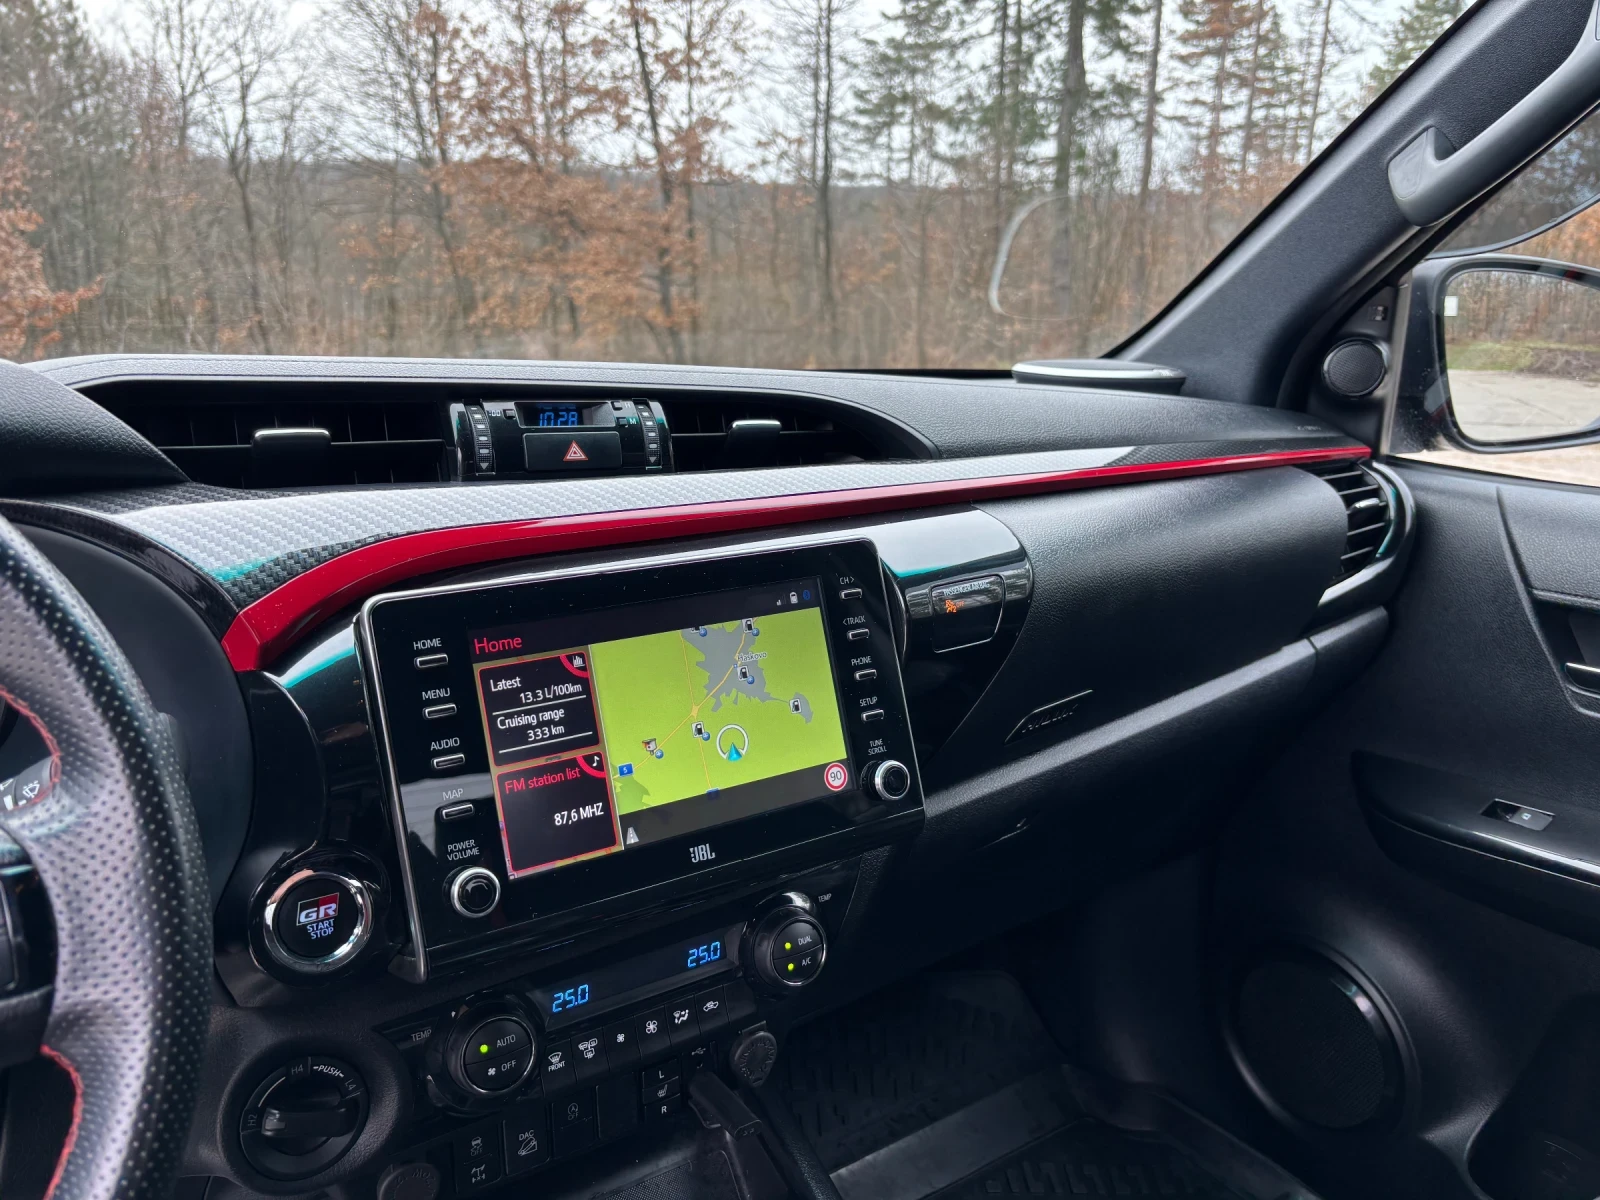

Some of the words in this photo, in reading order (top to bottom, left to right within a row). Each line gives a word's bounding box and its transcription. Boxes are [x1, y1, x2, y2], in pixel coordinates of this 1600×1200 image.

[413, 637, 442, 650] HOME
[474, 637, 522, 654] Home
[851, 655, 873, 667] PHONE
[490, 677, 521, 691] Latest
[421, 687, 451, 701] MENU
[520, 689, 544, 704] 13.3
[859, 696, 879, 707] SETUP
[496, 713, 537, 730] Cruising
[538, 708, 565, 722] range
[526, 726, 550, 742] 333
[550, 724, 565, 735] km
[430, 736, 461, 752] AUDIO
[869, 737, 884, 748] TUNE
[867, 745, 888, 757] SCROLL
[623, 766, 628, 774] 5
[830, 770, 843, 782] 90
[504, 778, 525, 794] FM
[528, 773, 565, 789] station
[565, 766, 582, 781] list
[442, 787, 465, 801] MAP
[553, 809, 580, 827] 87,6
[579, 801, 605, 818] MHZ
[447, 838, 477, 853] POWER
[446, 846, 481, 862] VOLUME
[690, 843, 716, 863] JBL
[817, 893, 832, 903] TEMP
[299, 903, 337, 922] GR
[306, 918, 335, 934] START
[309, 926, 334, 941] STOP
[797, 934, 813, 946] DUAL
[687, 941, 721, 968] 25.0
[801, 956, 812, 967] A/C
[552, 984, 589, 1013] 25.0
[411, 1028, 432, 1043] TEMP
[496, 1034, 517, 1049] AUTO
[291, 1063, 304, 1075] H4
[500, 1059, 517, 1072] OFF
[547, 1060, 566, 1073] FRONT
[658, 1070, 665, 1079] L
[344, 1078, 357, 1091] L4
[567, 1112, 579, 1121] OFF
[661, 1105, 668, 1115] R
[247, 1113, 258, 1126] H2
[518, 1129, 535, 1141] DAC
